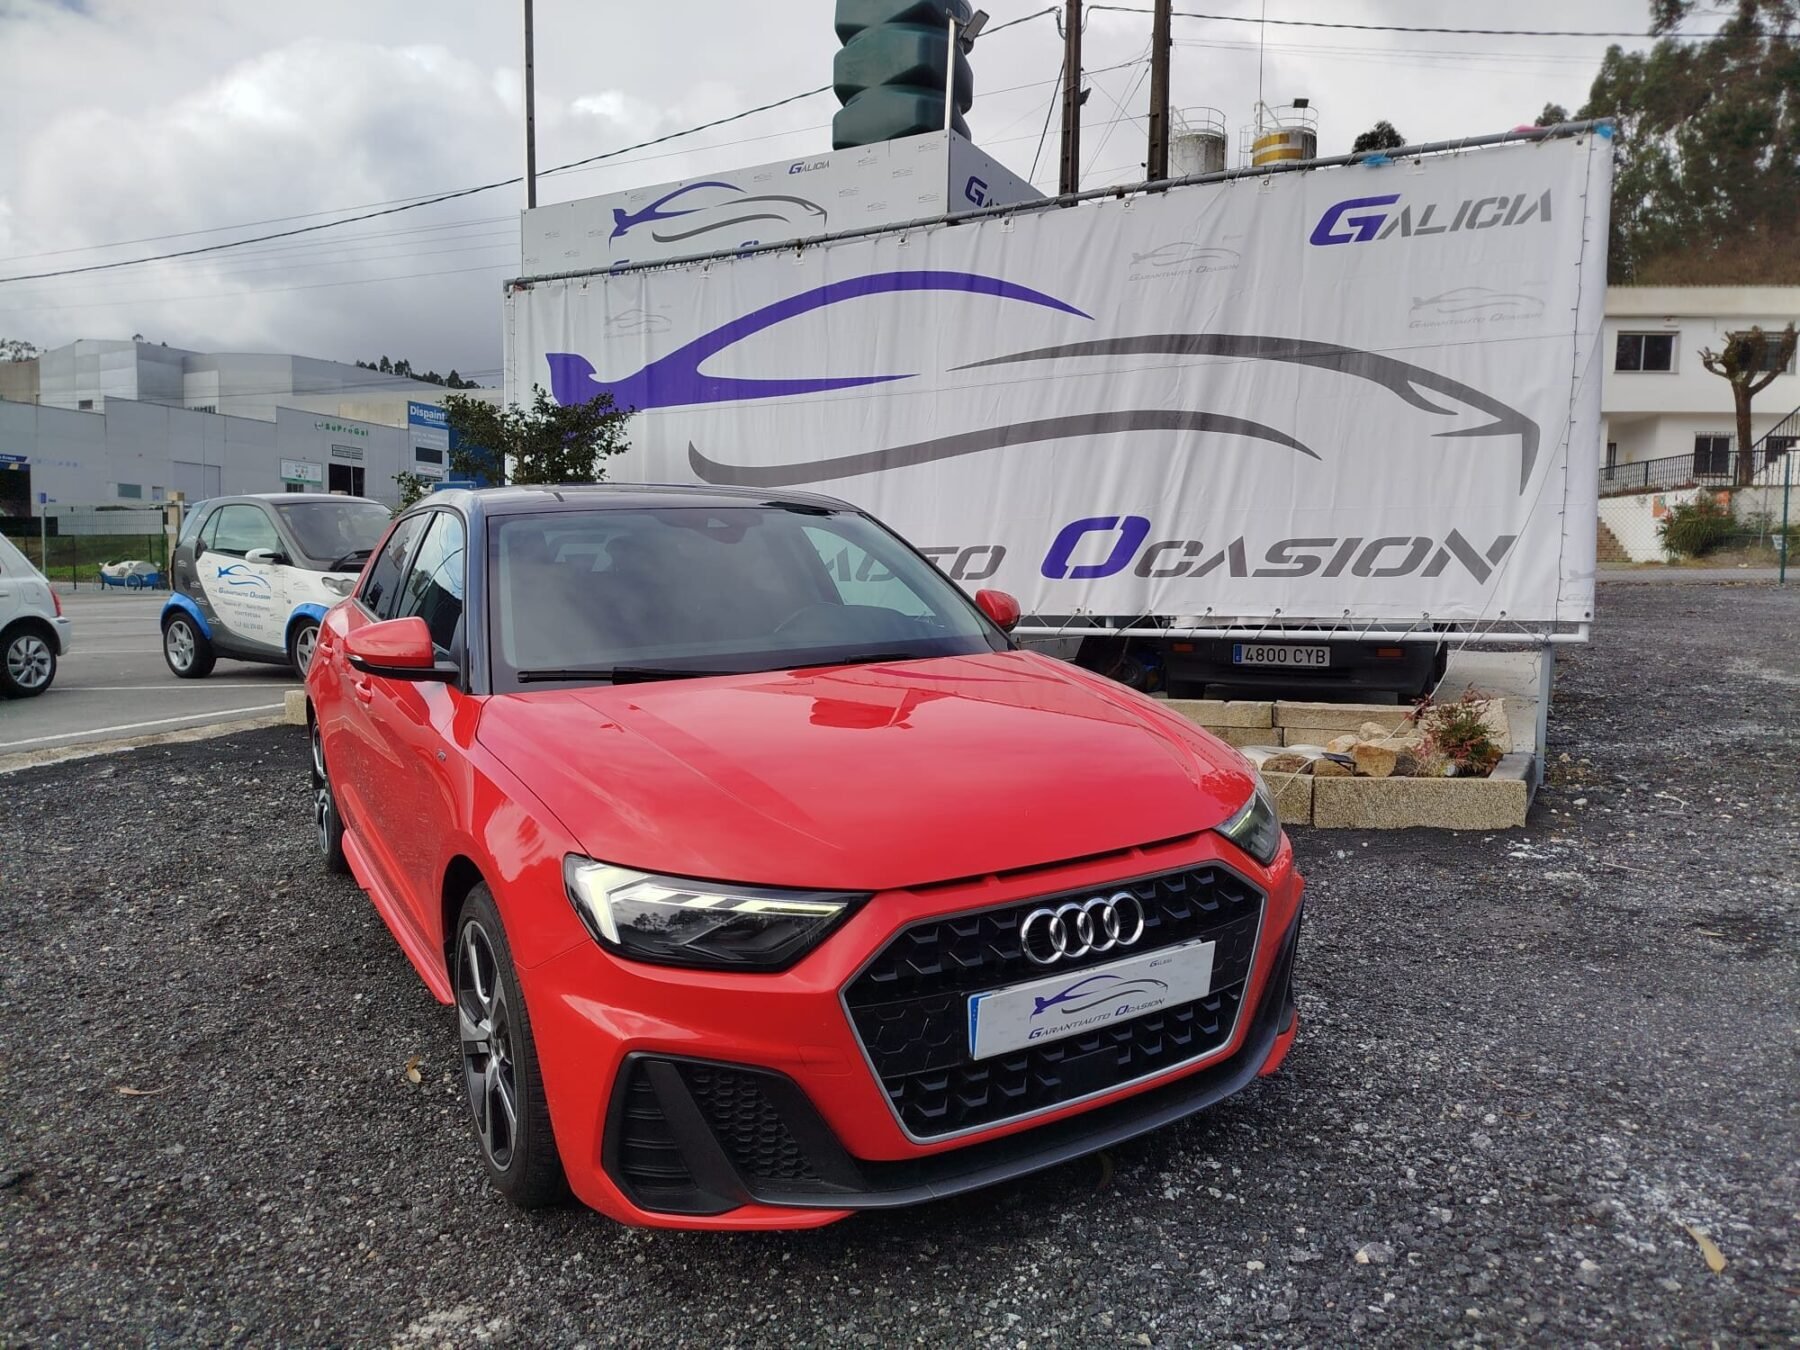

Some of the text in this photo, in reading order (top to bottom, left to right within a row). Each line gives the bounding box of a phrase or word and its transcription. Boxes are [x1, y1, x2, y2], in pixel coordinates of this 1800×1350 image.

[1309, 188, 1552, 246] GALICIA
[410, 406, 445, 421] Dispaint
[1040, 515, 1518, 585] OCASION
[1245, 648, 1326, 663] 4800 CYB
[1028, 998, 1165, 1040] GARANTIAUTO OCASION
